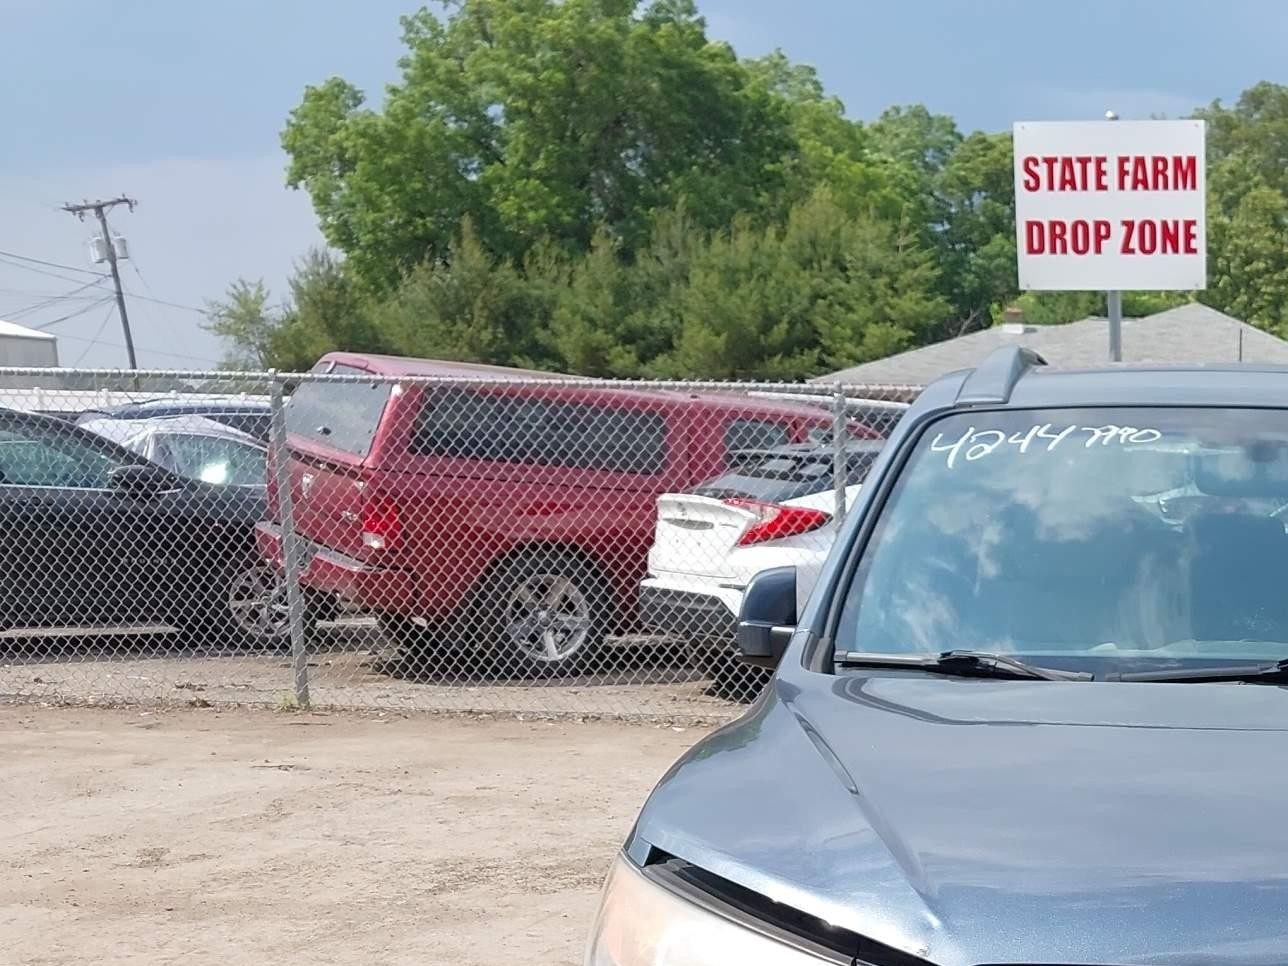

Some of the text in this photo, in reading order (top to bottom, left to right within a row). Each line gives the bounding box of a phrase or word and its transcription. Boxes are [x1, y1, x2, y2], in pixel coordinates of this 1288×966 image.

[1023, 155, 1197, 193] STATE FARM
[1025, 219, 1198, 256] DROP ZONE
